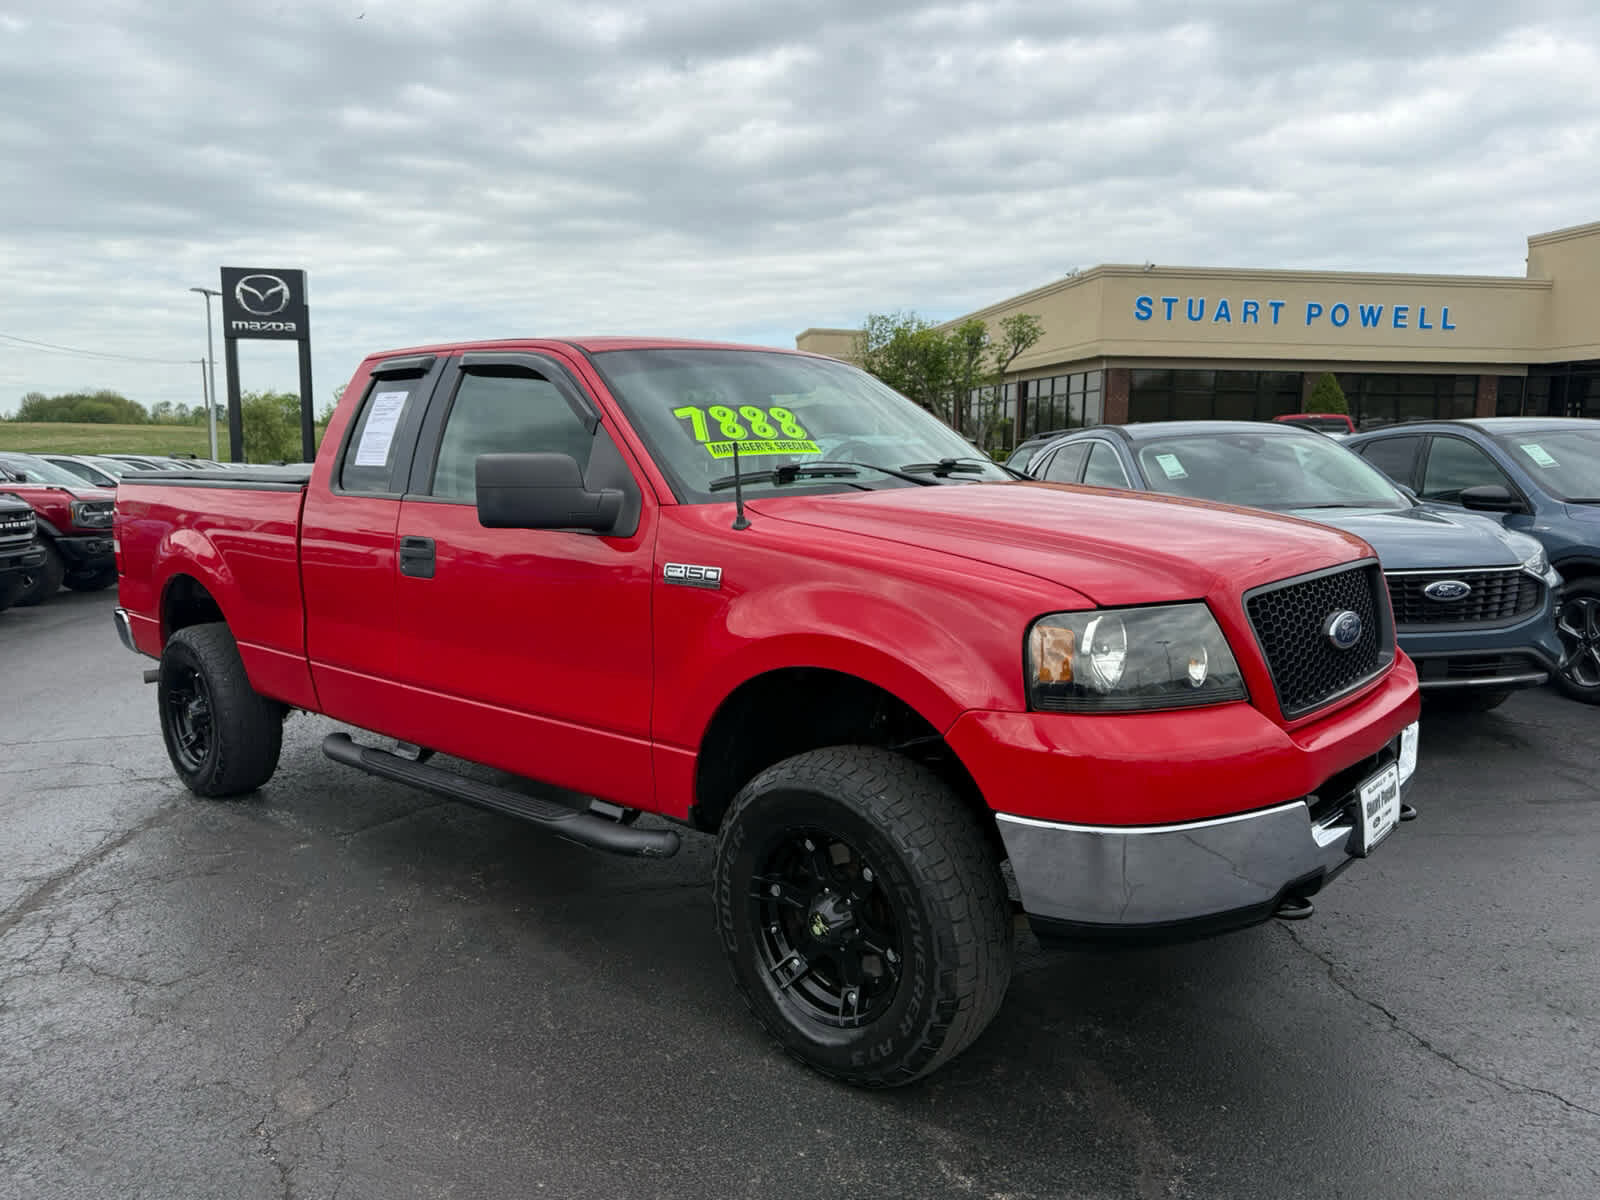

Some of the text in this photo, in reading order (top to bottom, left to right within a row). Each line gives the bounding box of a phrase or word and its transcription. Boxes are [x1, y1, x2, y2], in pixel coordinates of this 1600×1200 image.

[1134, 296, 1457, 331] STUART POWELL
[673, 405, 807, 442] 7888
[775, 439, 815, 451] SPECIAL
